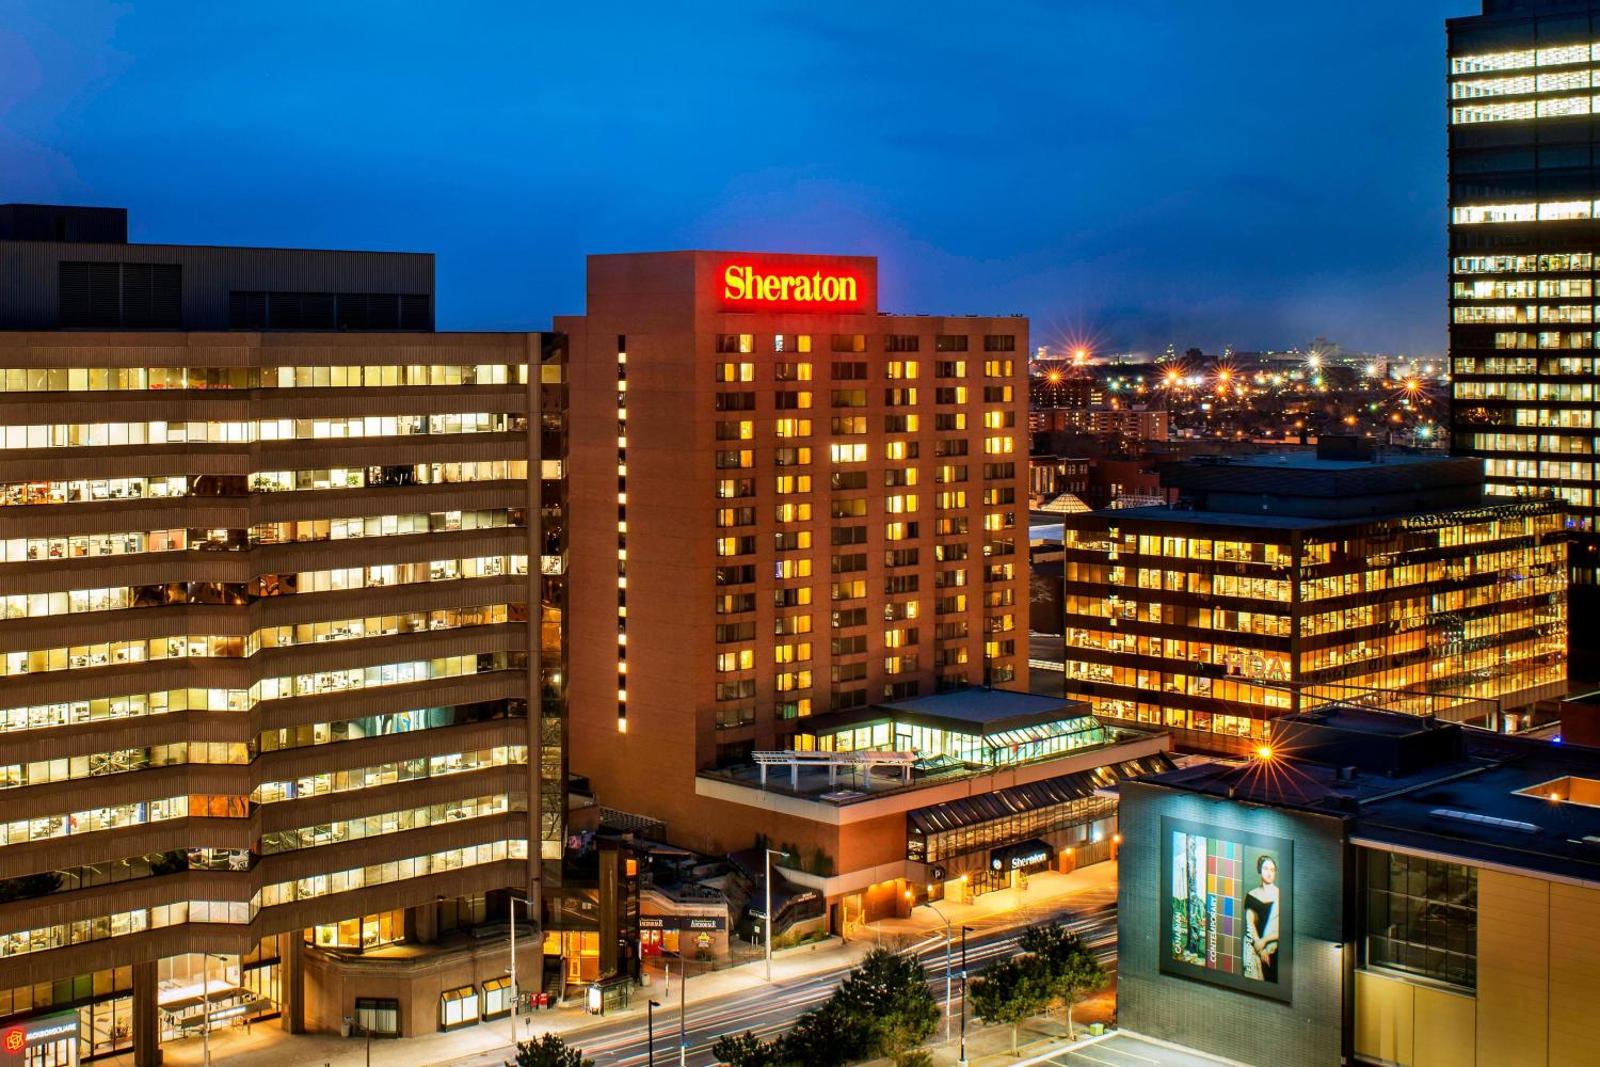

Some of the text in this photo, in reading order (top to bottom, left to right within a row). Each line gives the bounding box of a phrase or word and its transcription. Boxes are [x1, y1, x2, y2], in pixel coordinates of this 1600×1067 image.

[724, 265, 857, 302] Sheraton
[1011, 852, 1047, 869] Sheraton
[1209, 896, 1217, 963] CONTEMPORARY
